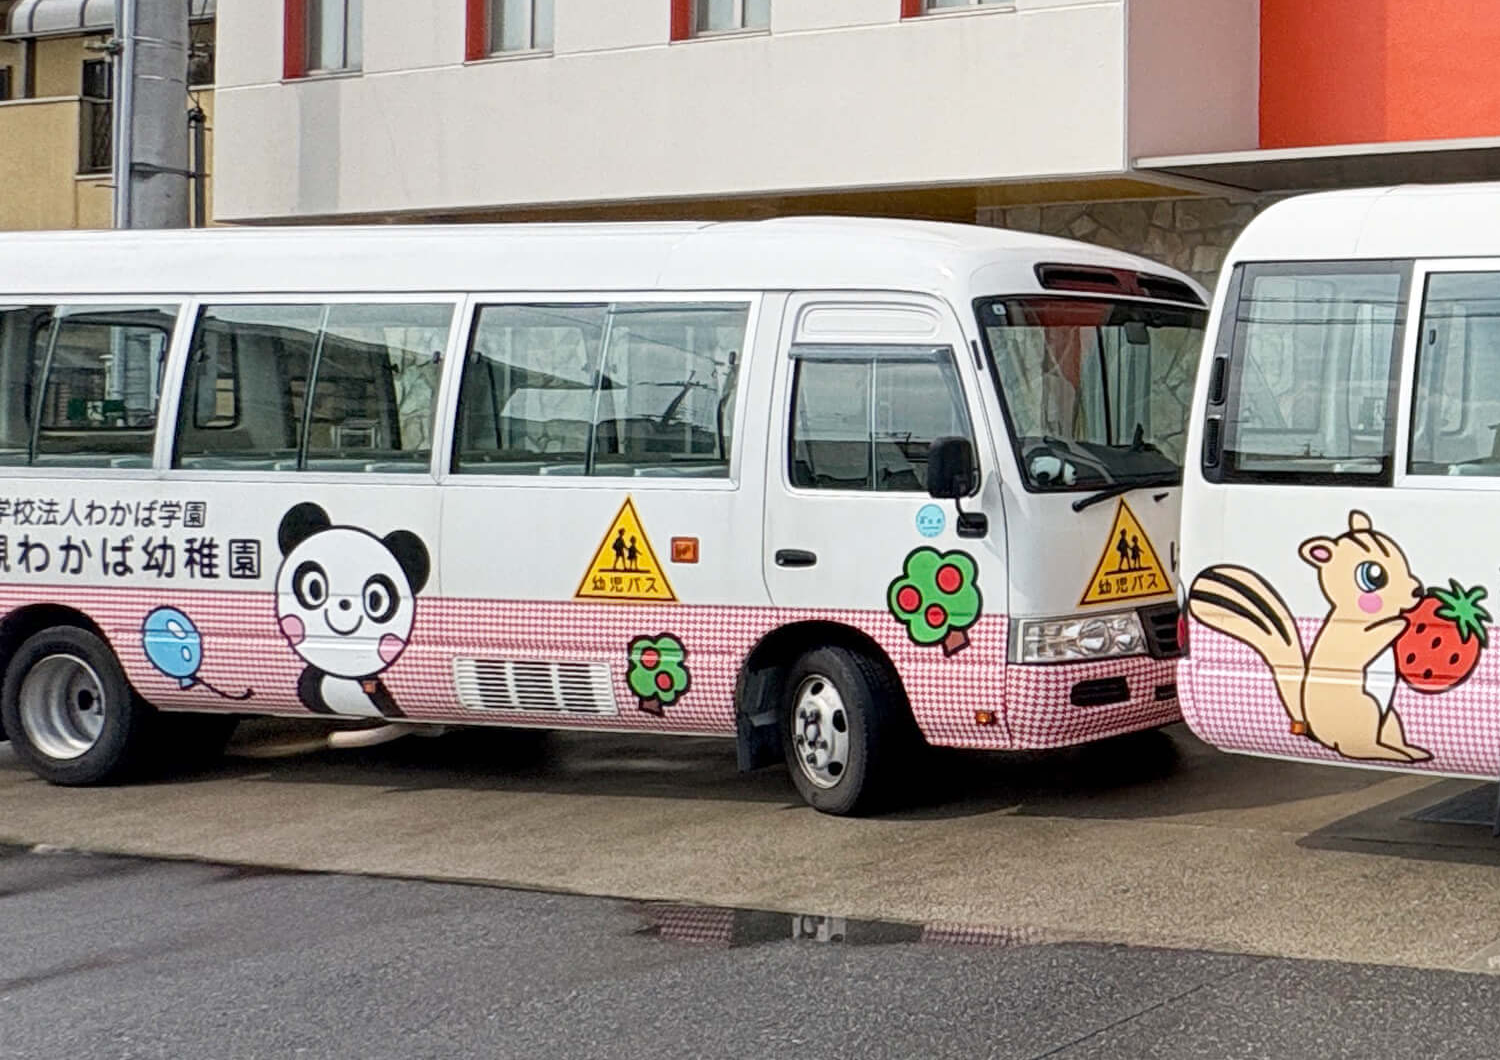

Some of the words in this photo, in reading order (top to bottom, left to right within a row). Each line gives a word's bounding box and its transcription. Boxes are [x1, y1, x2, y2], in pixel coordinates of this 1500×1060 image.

[0, 534, 262, 580] わかば幼稚園
[592, 576, 658, 593] 幼児バス
[1098, 573, 1158, 595] 幼児バス
